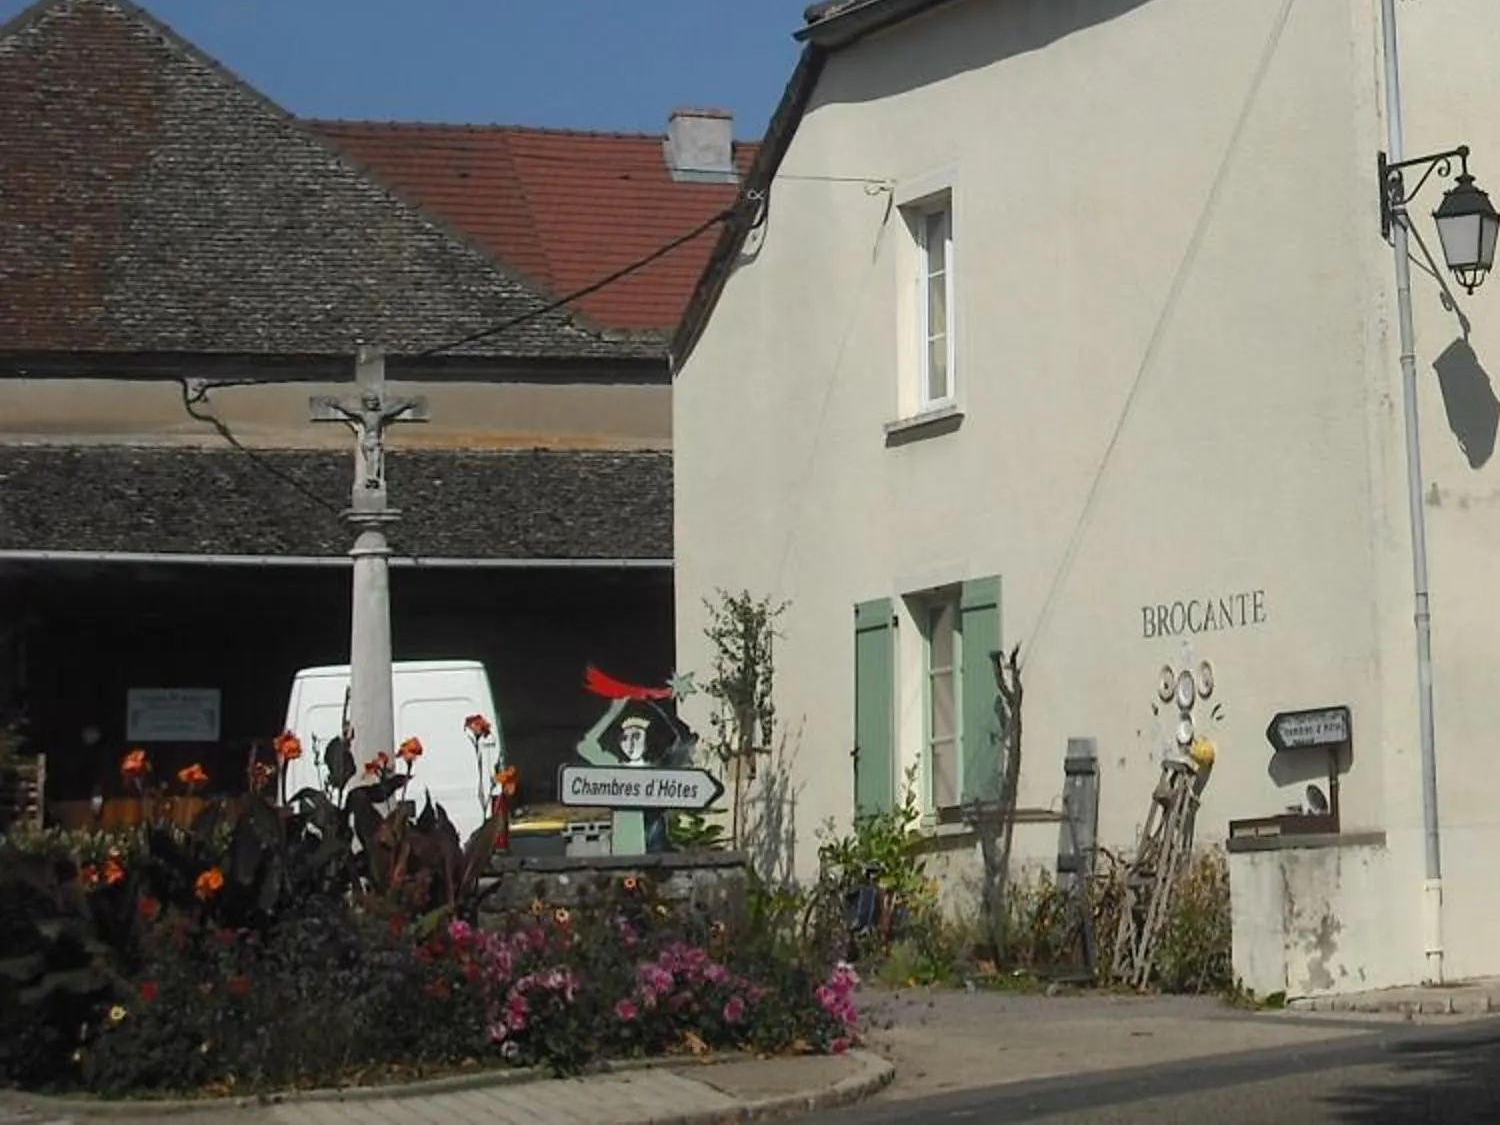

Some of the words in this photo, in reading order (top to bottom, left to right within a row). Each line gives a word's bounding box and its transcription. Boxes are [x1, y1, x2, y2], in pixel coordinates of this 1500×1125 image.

[1142, 590, 1267, 638] BROCANTE
[571, 777, 640, 796] Chambres
[645, 778, 698, 798] d'Hôtes
